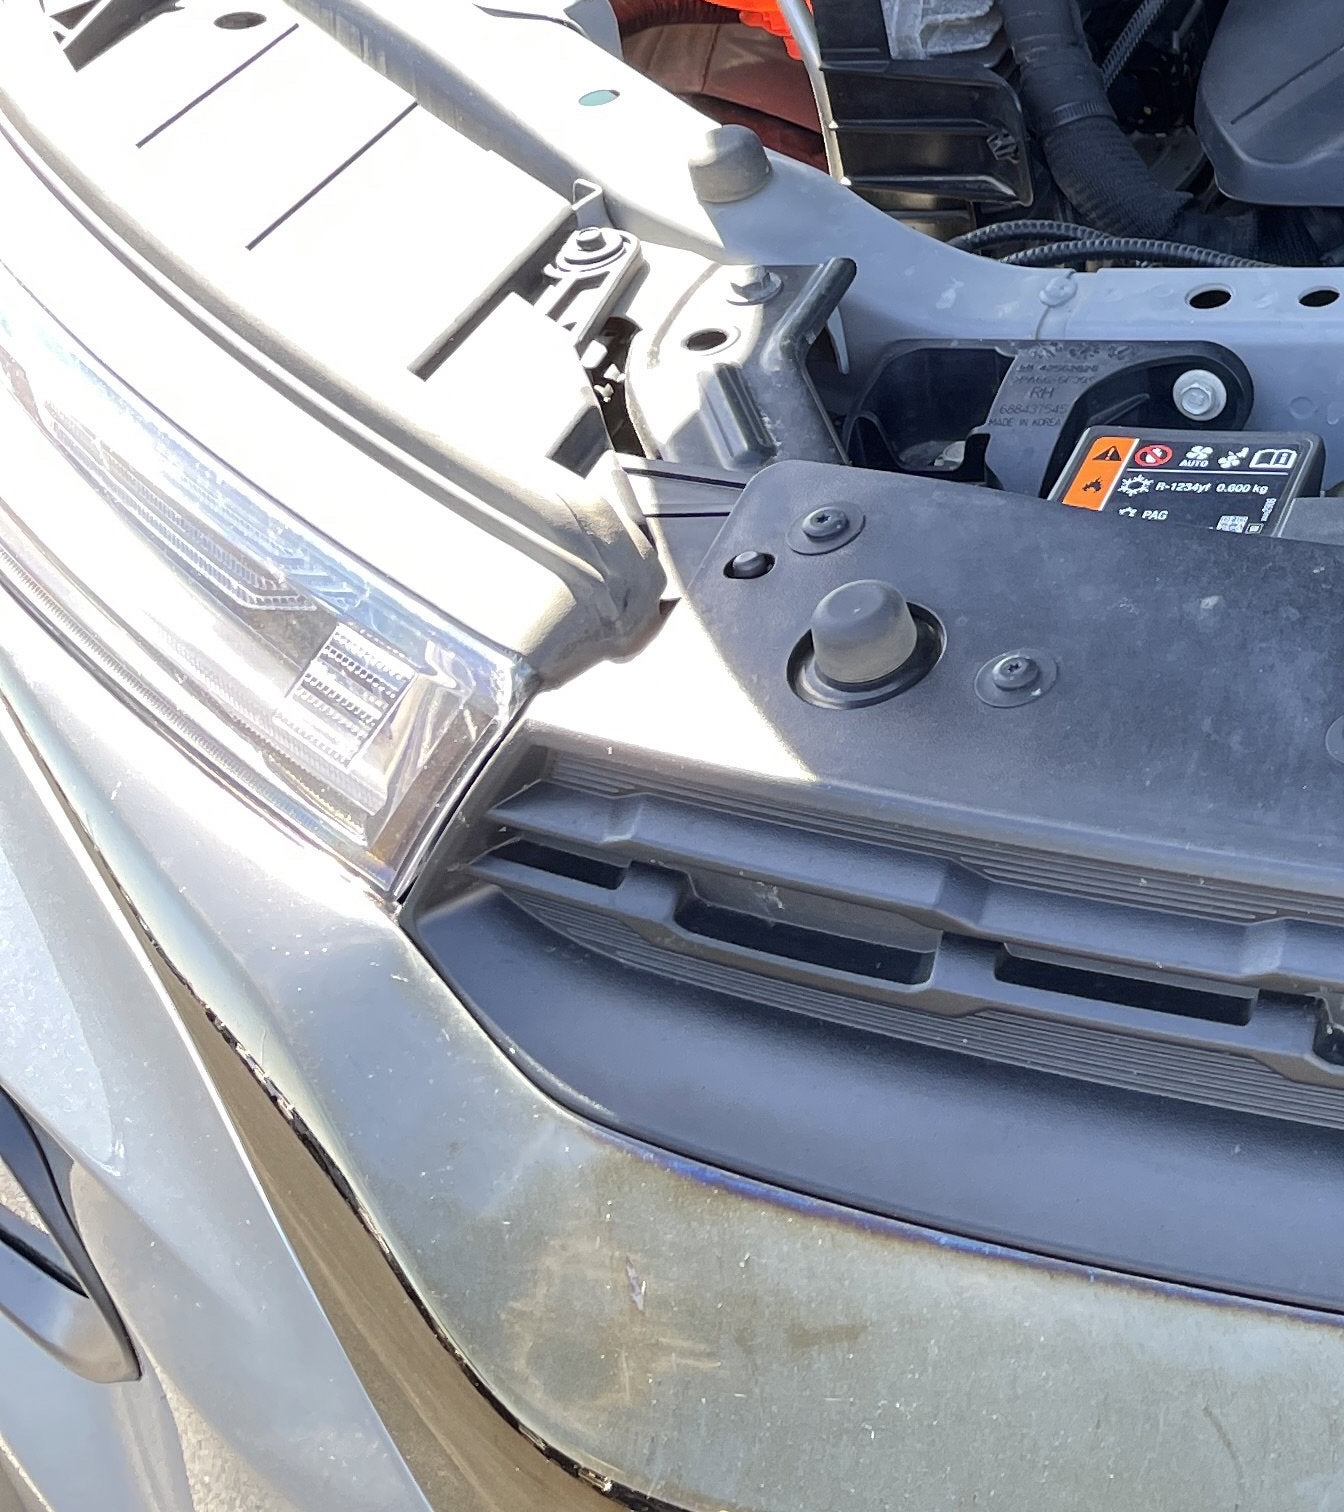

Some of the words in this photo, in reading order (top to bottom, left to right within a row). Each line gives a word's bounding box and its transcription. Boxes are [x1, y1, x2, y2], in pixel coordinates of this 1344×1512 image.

[1029, 386, 1055, 399] RH
[989, 418, 1014, 427] MADE
[1019, 419, 1028, 427] IN
[1032, 419, 1062, 427] KOREA
[1178, 459, 1209, 468] AUTO
[1155, 482, 1211, 493] R-1234yf
[1216, 483, 1250, 493] 0.600
[1252, 484, 1269, 494] kg
[1141, 509, 1169, 520] PAG
